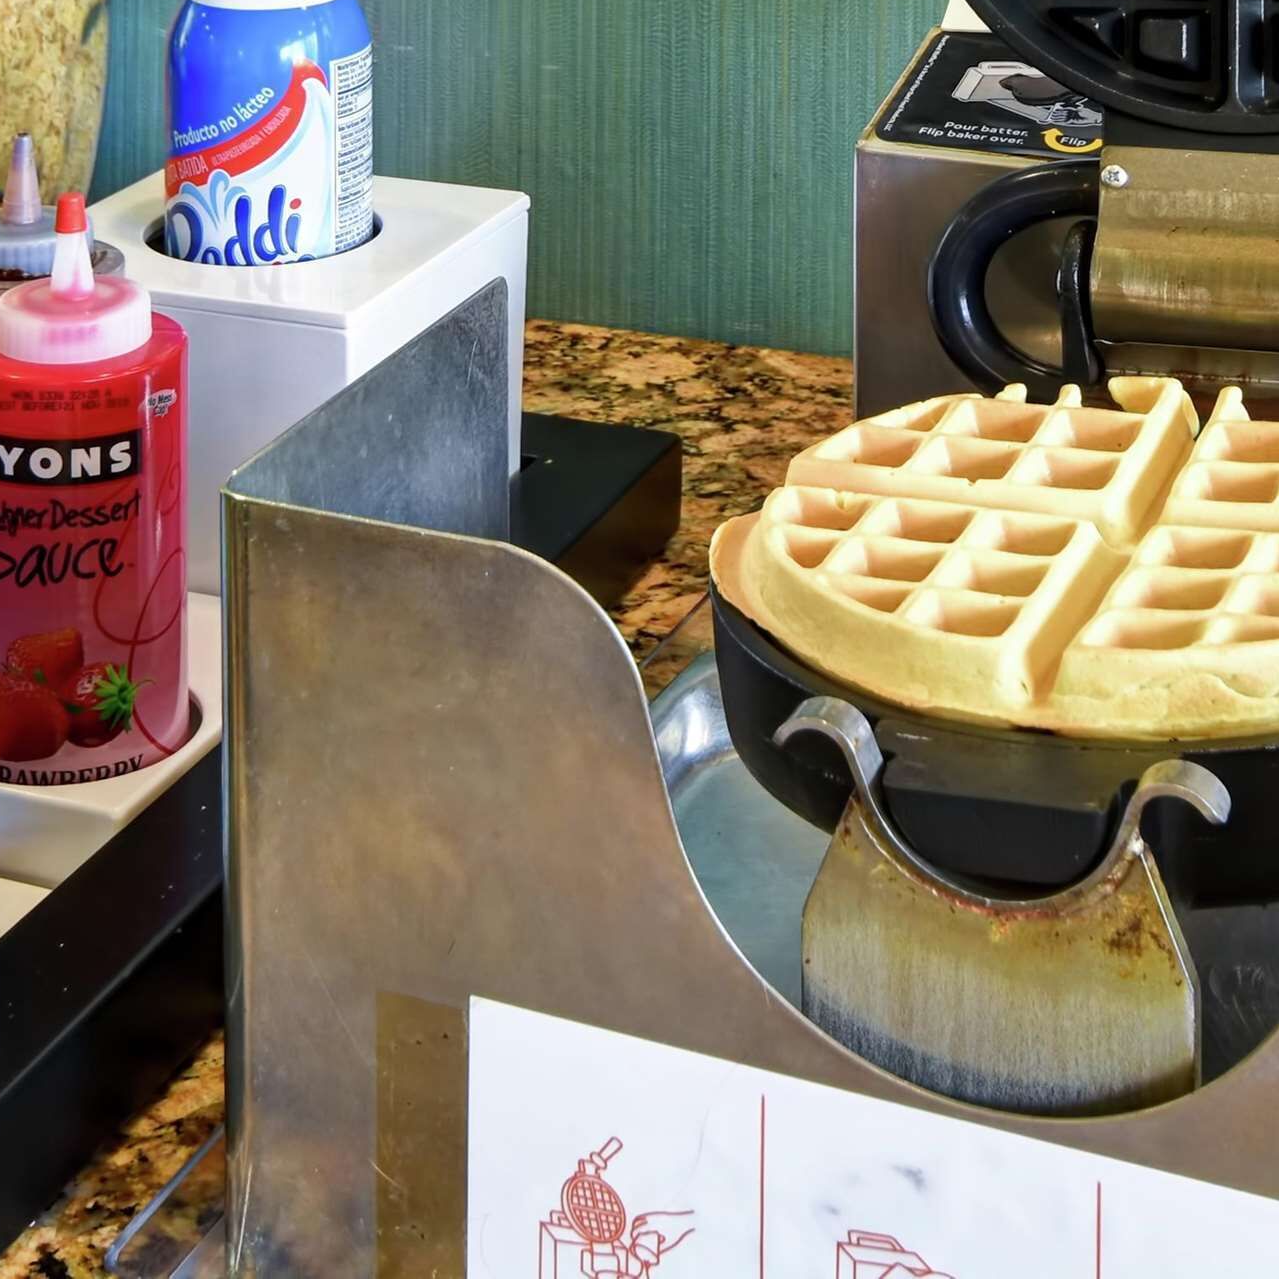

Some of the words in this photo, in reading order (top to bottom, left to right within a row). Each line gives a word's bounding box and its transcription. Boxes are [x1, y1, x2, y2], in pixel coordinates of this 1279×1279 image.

[173, 124, 219, 148] Producto
[219, 115, 238, 133] no
[232, 87, 275, 122] lácteo
[918, 126, 945, 138] Flip
[947, 128, 987, 141] baker
[990, 133, 1024, 145] over.
[943, 121, 976, 133] Pour
[980, 124, 1029, 137] batter.
[1060, 136, 1087, 148] Flip
[49, 488, 142, 531] Dessert
